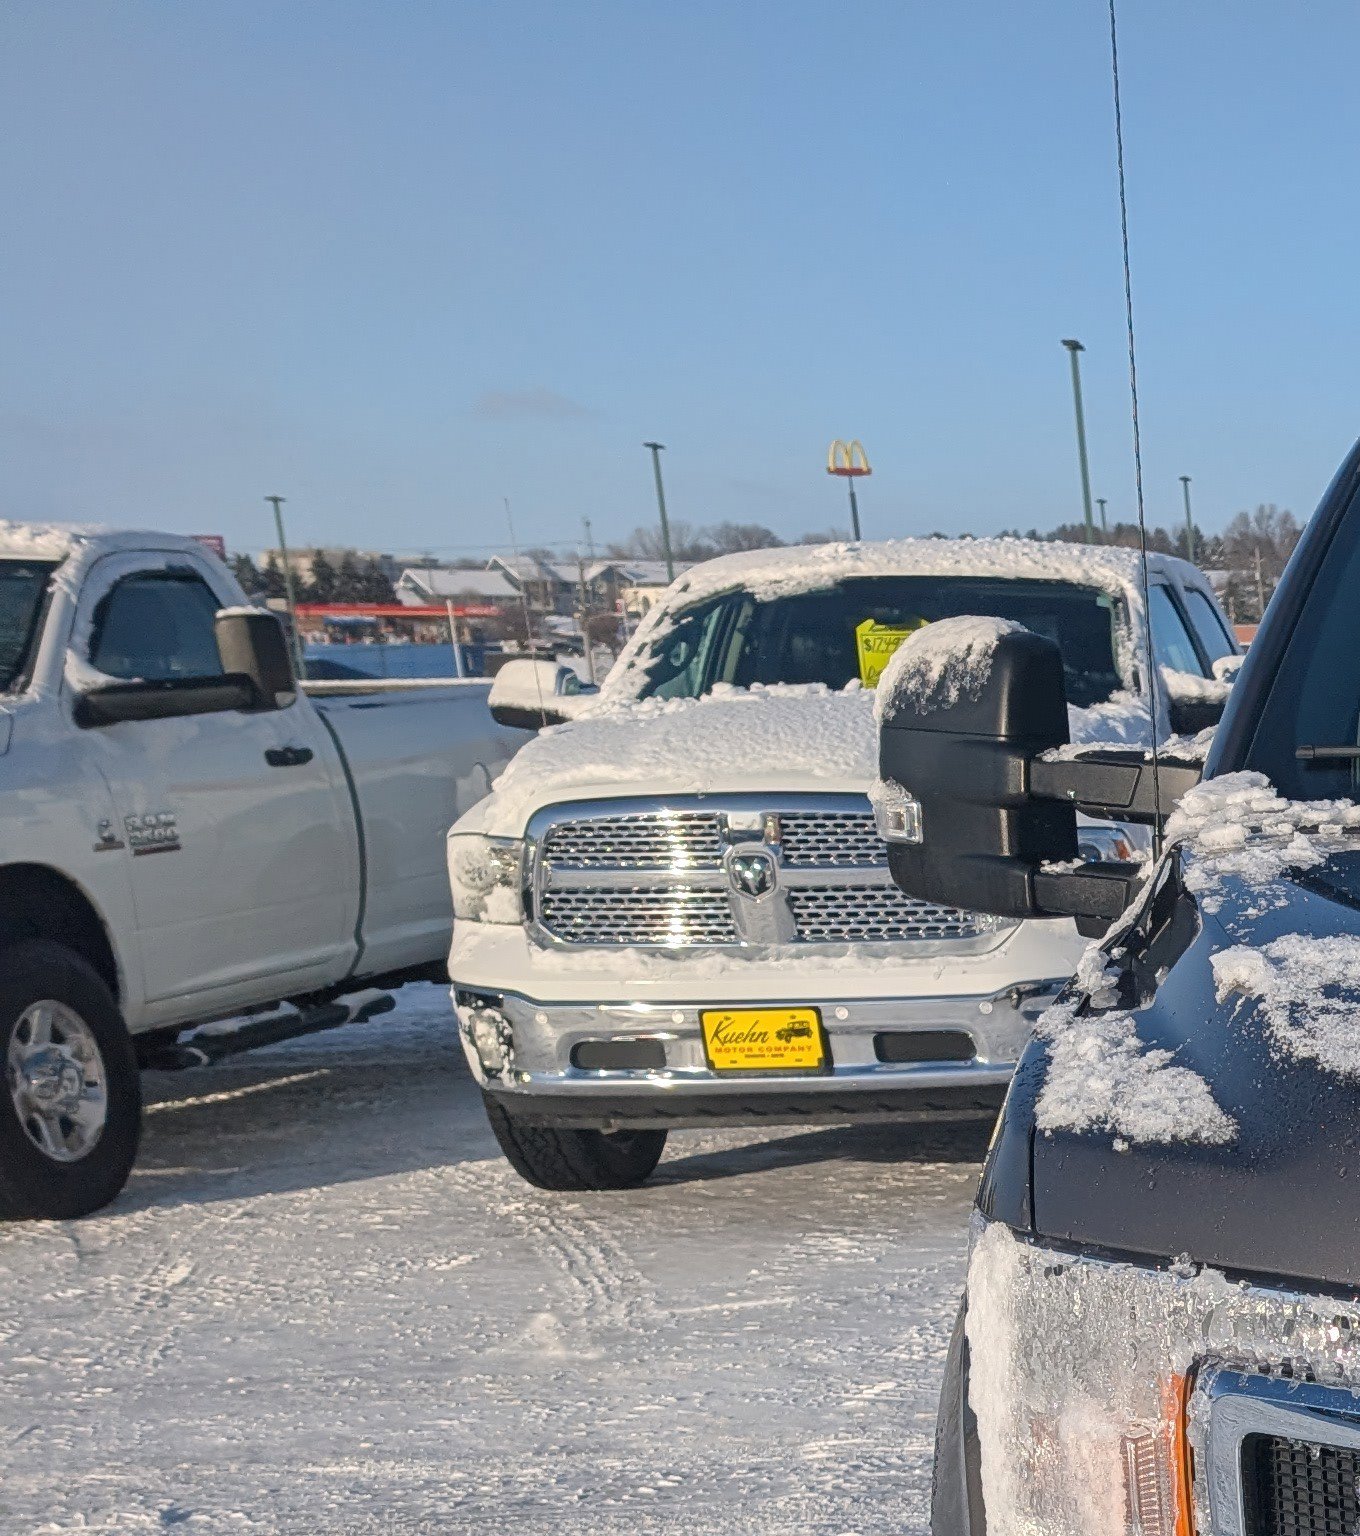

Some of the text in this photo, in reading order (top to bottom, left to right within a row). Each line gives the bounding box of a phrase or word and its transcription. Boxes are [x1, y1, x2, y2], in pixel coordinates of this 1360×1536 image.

[709, 1019, 770, 1047] Kuehn
[714, 1045, 812, 1054] MOTOR COMPANY
